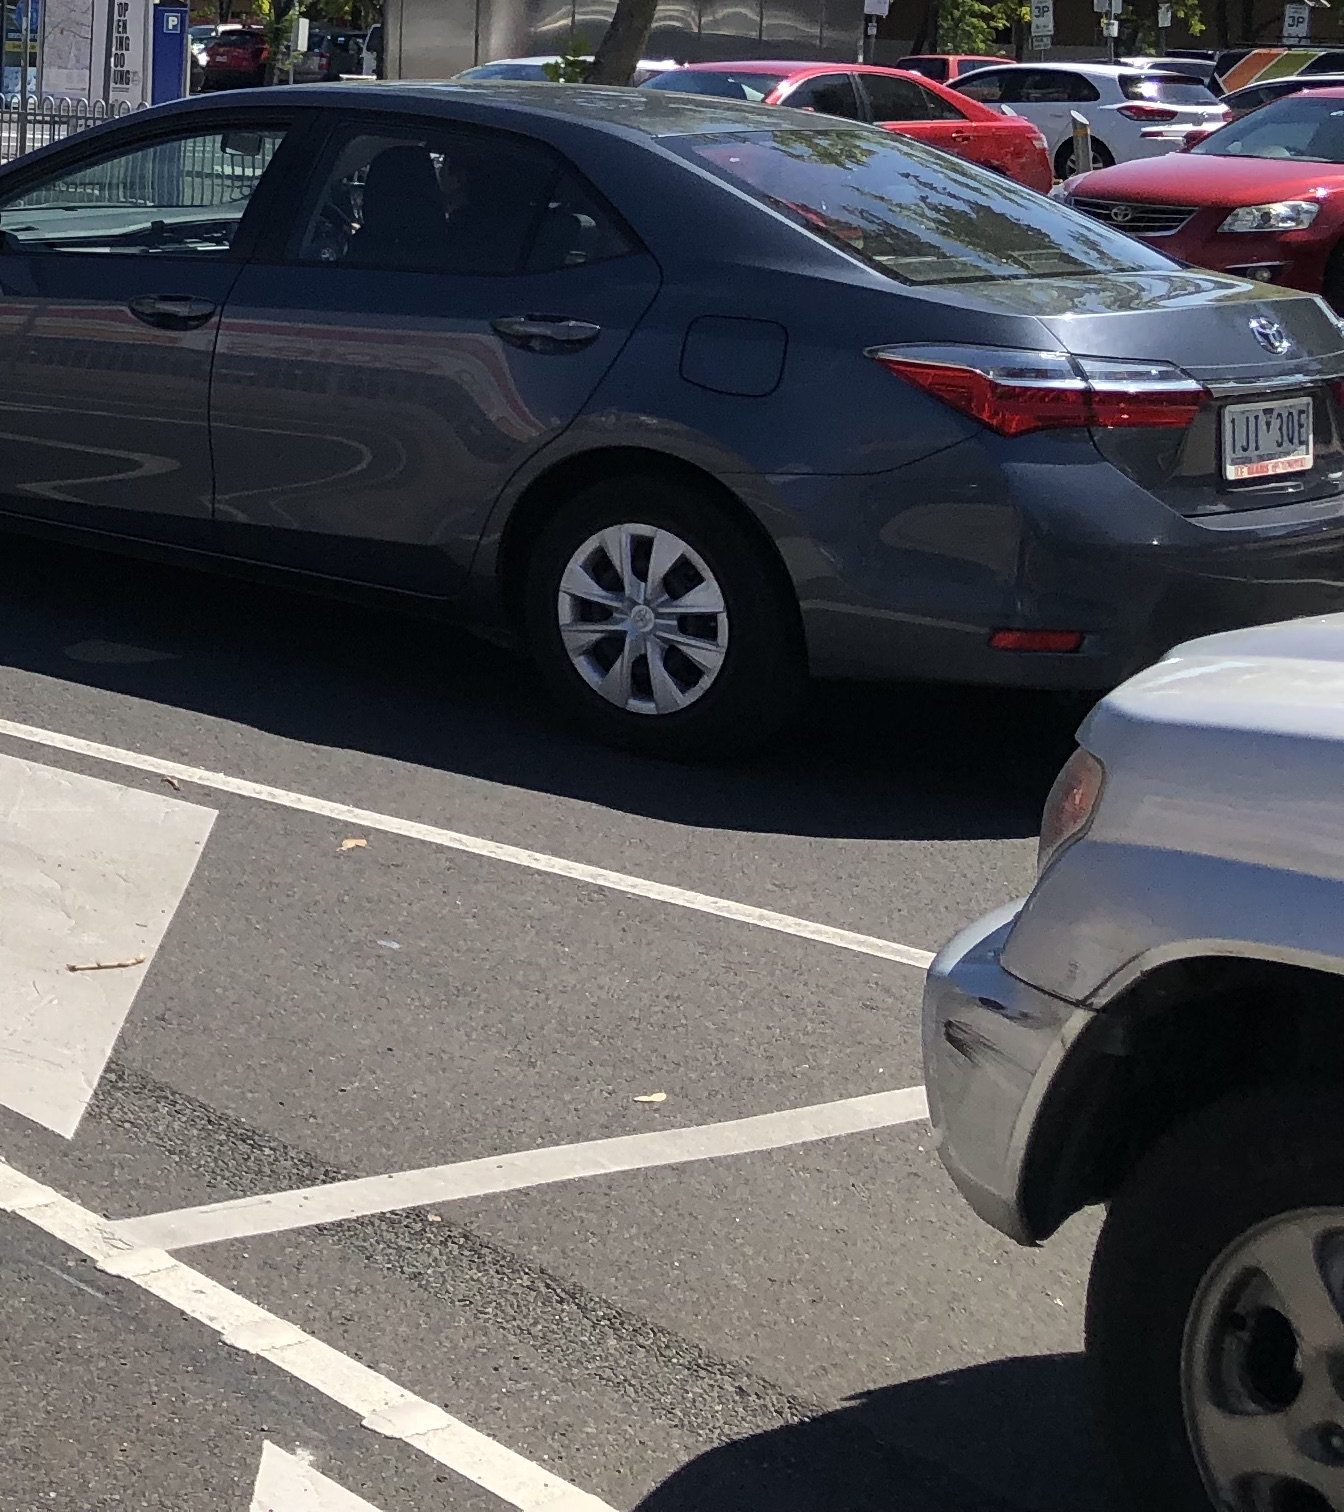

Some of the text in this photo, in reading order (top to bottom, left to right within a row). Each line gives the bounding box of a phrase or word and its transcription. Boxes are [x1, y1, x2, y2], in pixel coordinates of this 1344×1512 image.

[1033, 5, 1050, 19] 3P
[168, 16, 178, 30] P
[113, 52, 126, 69] OO
